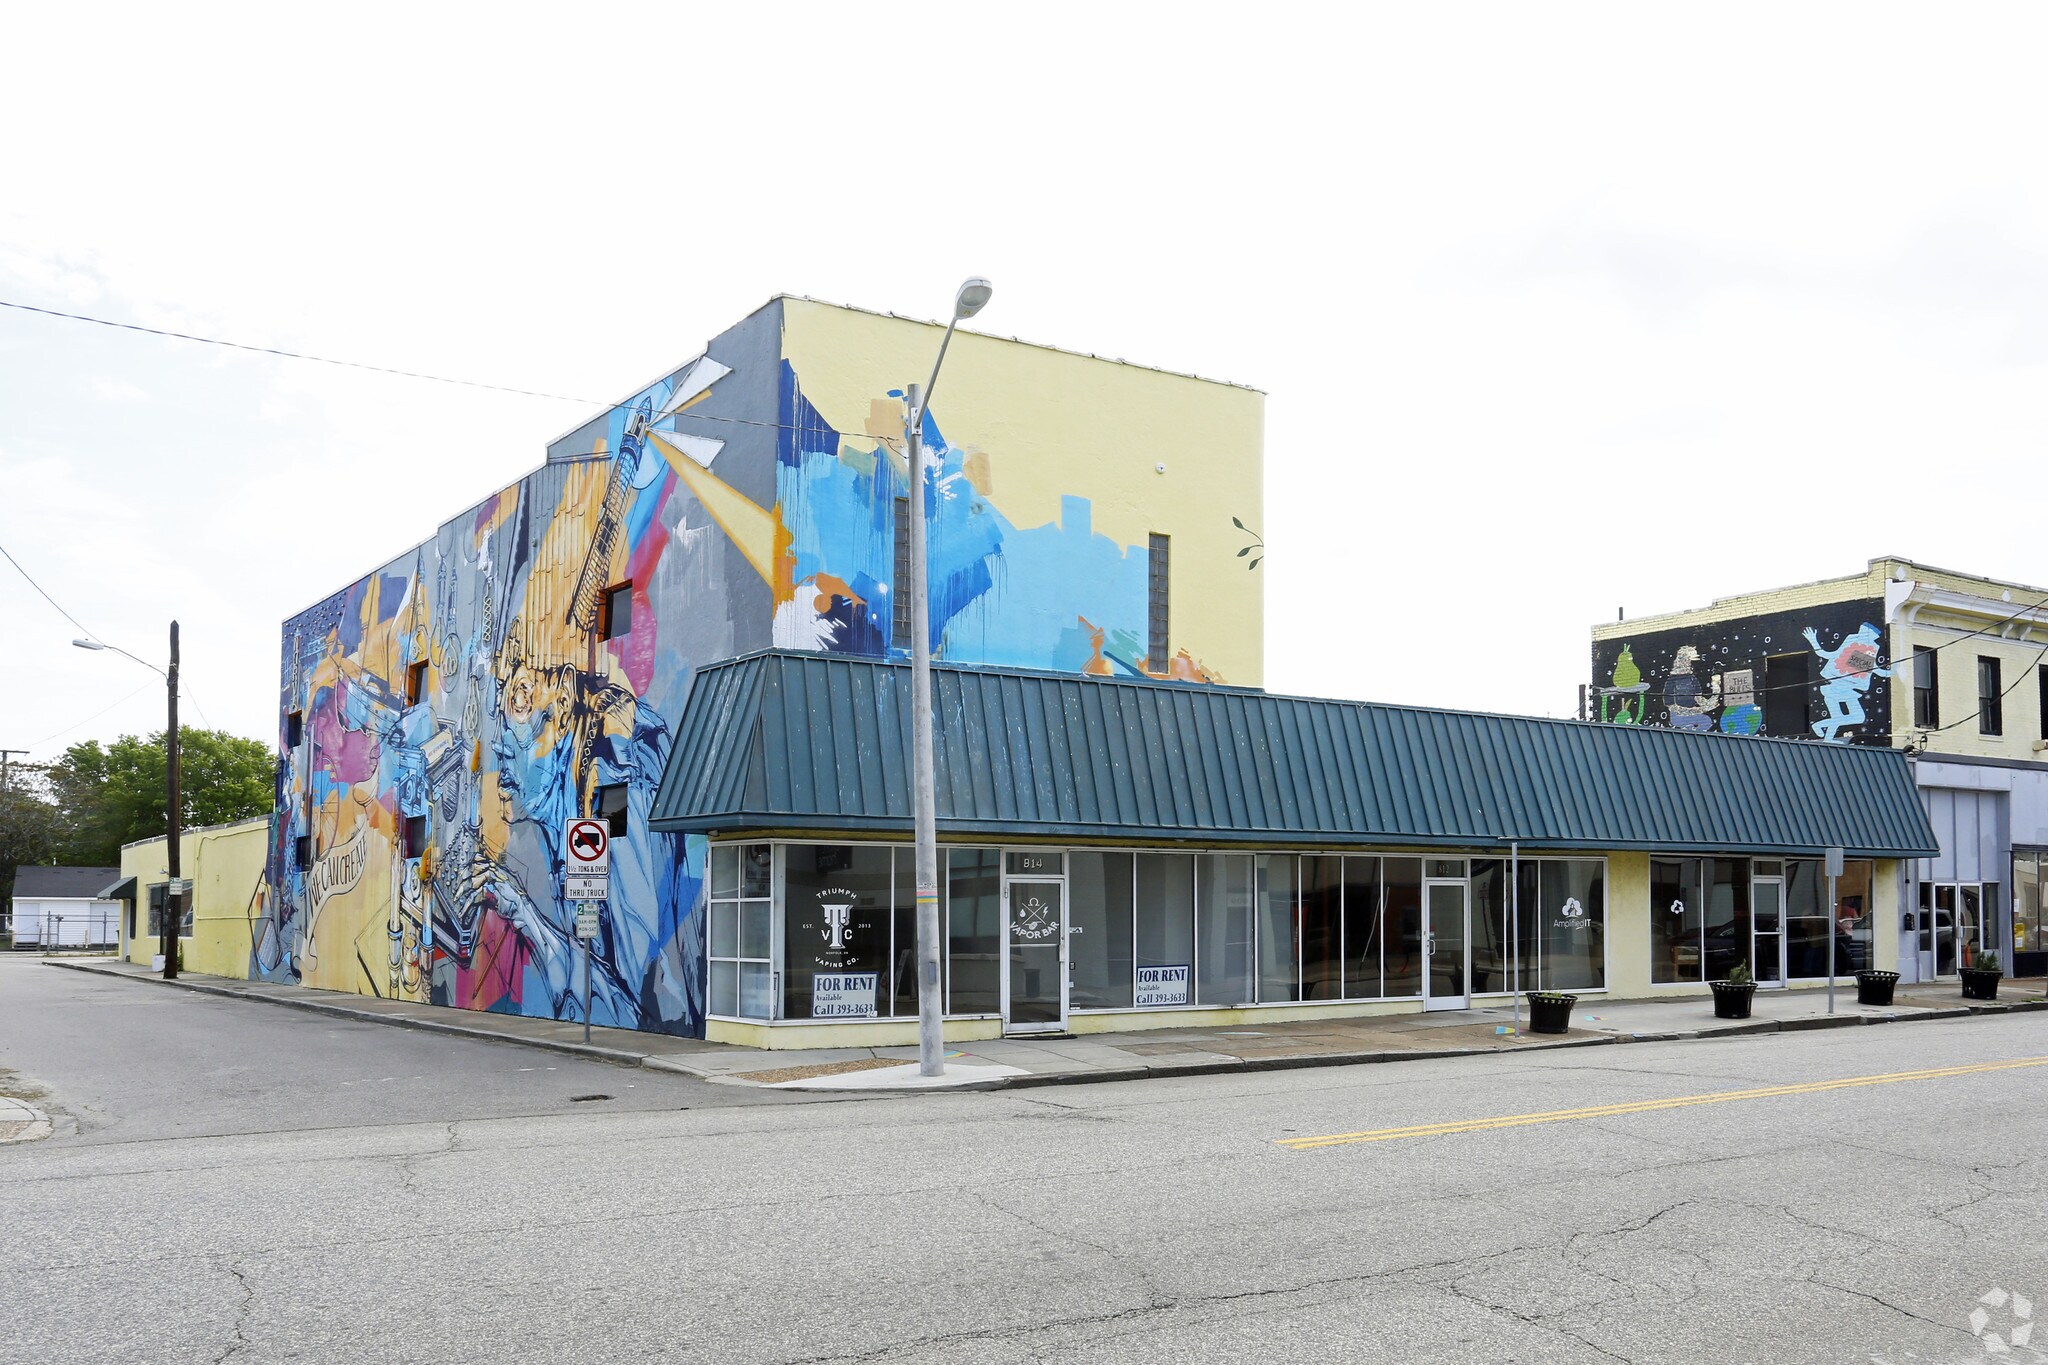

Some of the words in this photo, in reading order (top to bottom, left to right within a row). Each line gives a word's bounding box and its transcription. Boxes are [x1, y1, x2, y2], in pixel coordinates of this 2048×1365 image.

[1850, 654, 1873, 669] SPECIAL
[1733, 677, 1748, 686] THE
[578, 865, 590, 873] TONS
[595, 865, 607, 873] OVER
[1023, 858, 1043, 868] 814
[1438, 864, 1450, 874] 812
[308, 868, 324, 918] WE
[321, 855, 340, 892] CAN
[583, 880, 592, 888] NO
[570, 889, 585, 897] THRU
[587, 889, 605, 897] TRUCK
[816, 888, 857, 900] TRIUMPH
[578, 905, 583, 915] 2
[1010, 921, 1041, 939] VAPOR
[1041, 921, 1059, 937] BAR
[815, 956, 843, 968] VAPING
[846, 957, 860, 966] CO.
[1138, 970, 1159, 983] FOR
[1161, 969, 1186, 982] RENT
[816, 977, 841, 992] FOR
[844, 976, 875, 991] RENT
[815, 993, 842, 1002] Available
[1136, 994, 1153, 1004] Call
[1155, 992, 1186, 1003] 393-3633
[814, 1004, 834, 1015] Call
[837, 1003, 874, 1015] 393-3633
